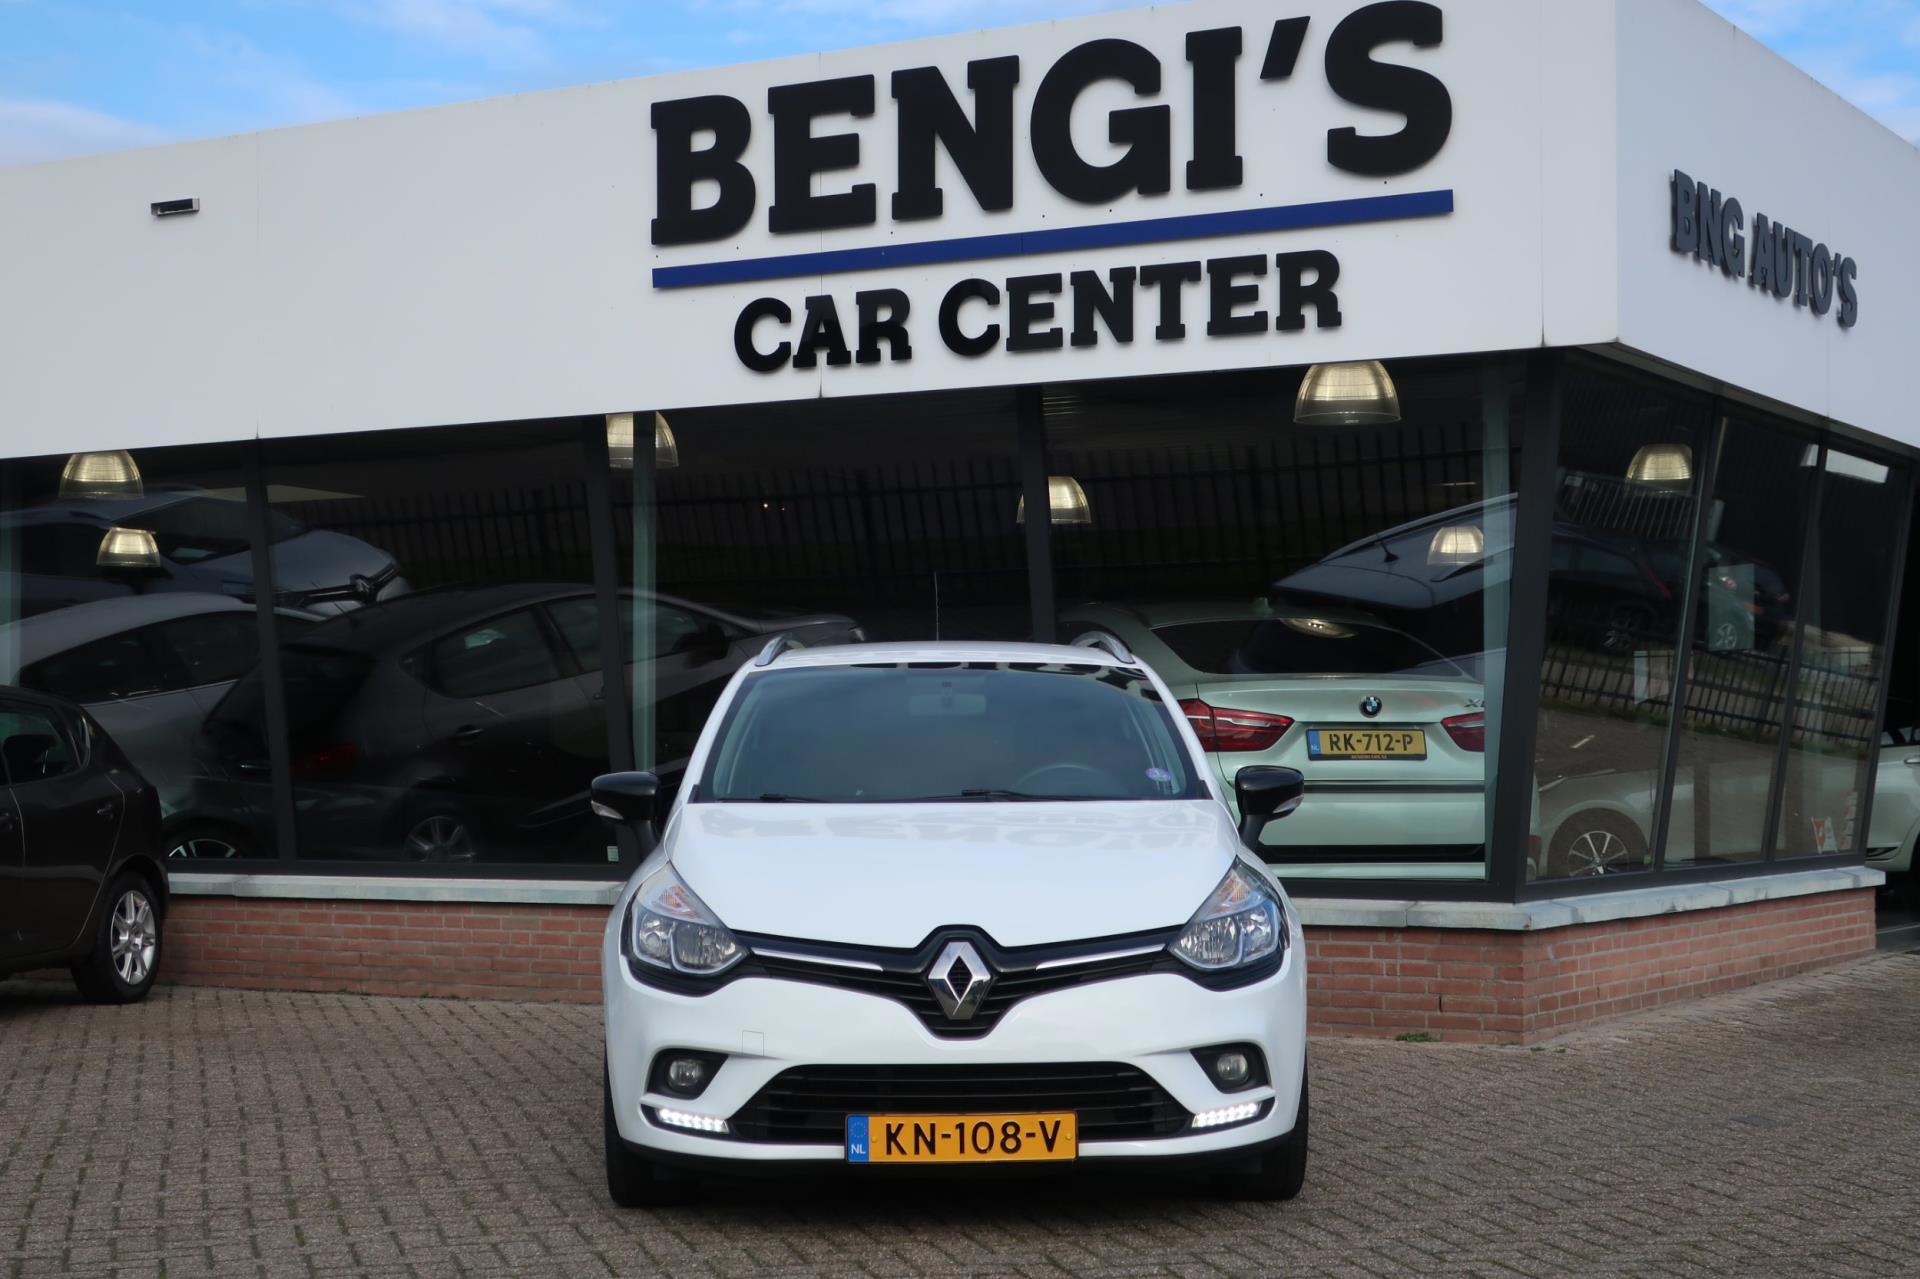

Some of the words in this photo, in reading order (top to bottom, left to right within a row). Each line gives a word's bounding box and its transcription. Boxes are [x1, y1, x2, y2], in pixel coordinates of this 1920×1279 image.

[651, 1, 1453, 247] BENGI'S
[1670, 168, 1745, 278] BNG
[1750, 212, 1858, 328] AUTO'S
[734, 287, 913, 373] CAR
[938, 249, 1342, 358] CENTER
[1329, 733, 1414, 752] RK-712-P
[851, 1144, 867, 1155] NL
[885, 1120, 1062, 1156] KN-108-V
